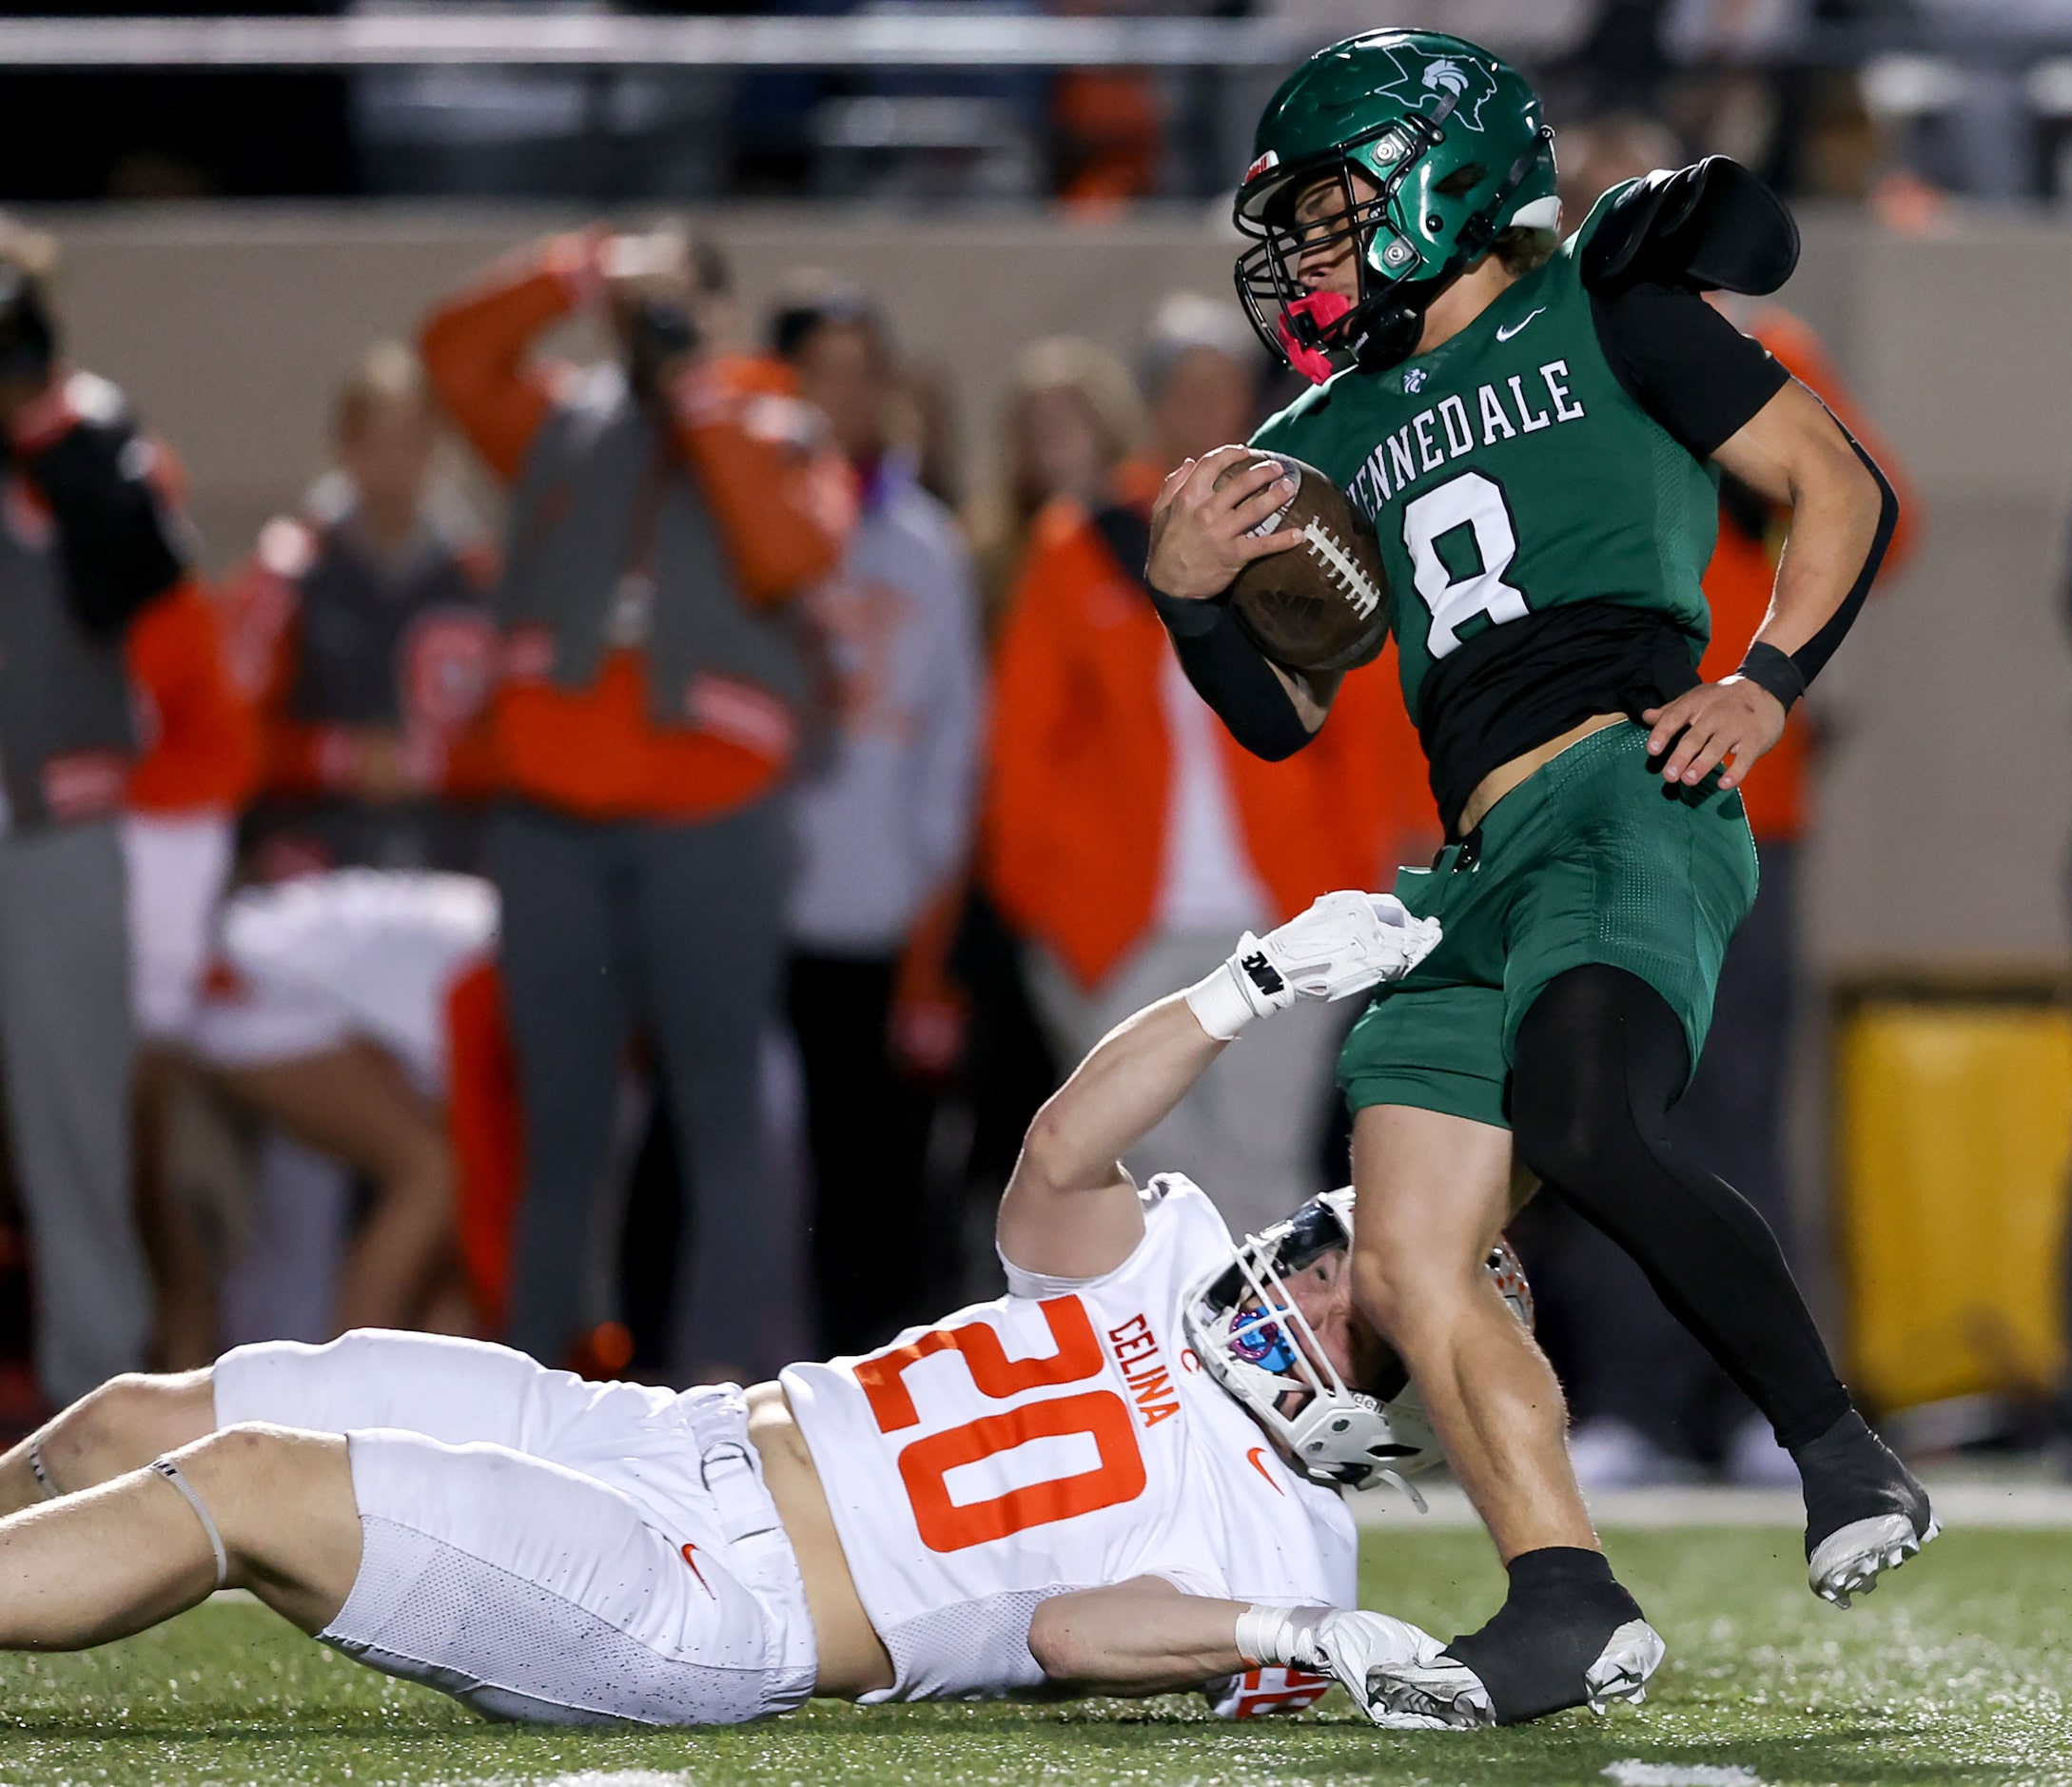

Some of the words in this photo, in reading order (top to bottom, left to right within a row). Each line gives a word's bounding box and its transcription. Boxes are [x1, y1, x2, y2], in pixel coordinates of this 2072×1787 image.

[1403, 471, 1530, 659] 8
[852, 1294, 1146, 1553] 20
[1108, 1313, 1181, 1428] CELINA
[1352, 1392, 1385, 1414] dell
